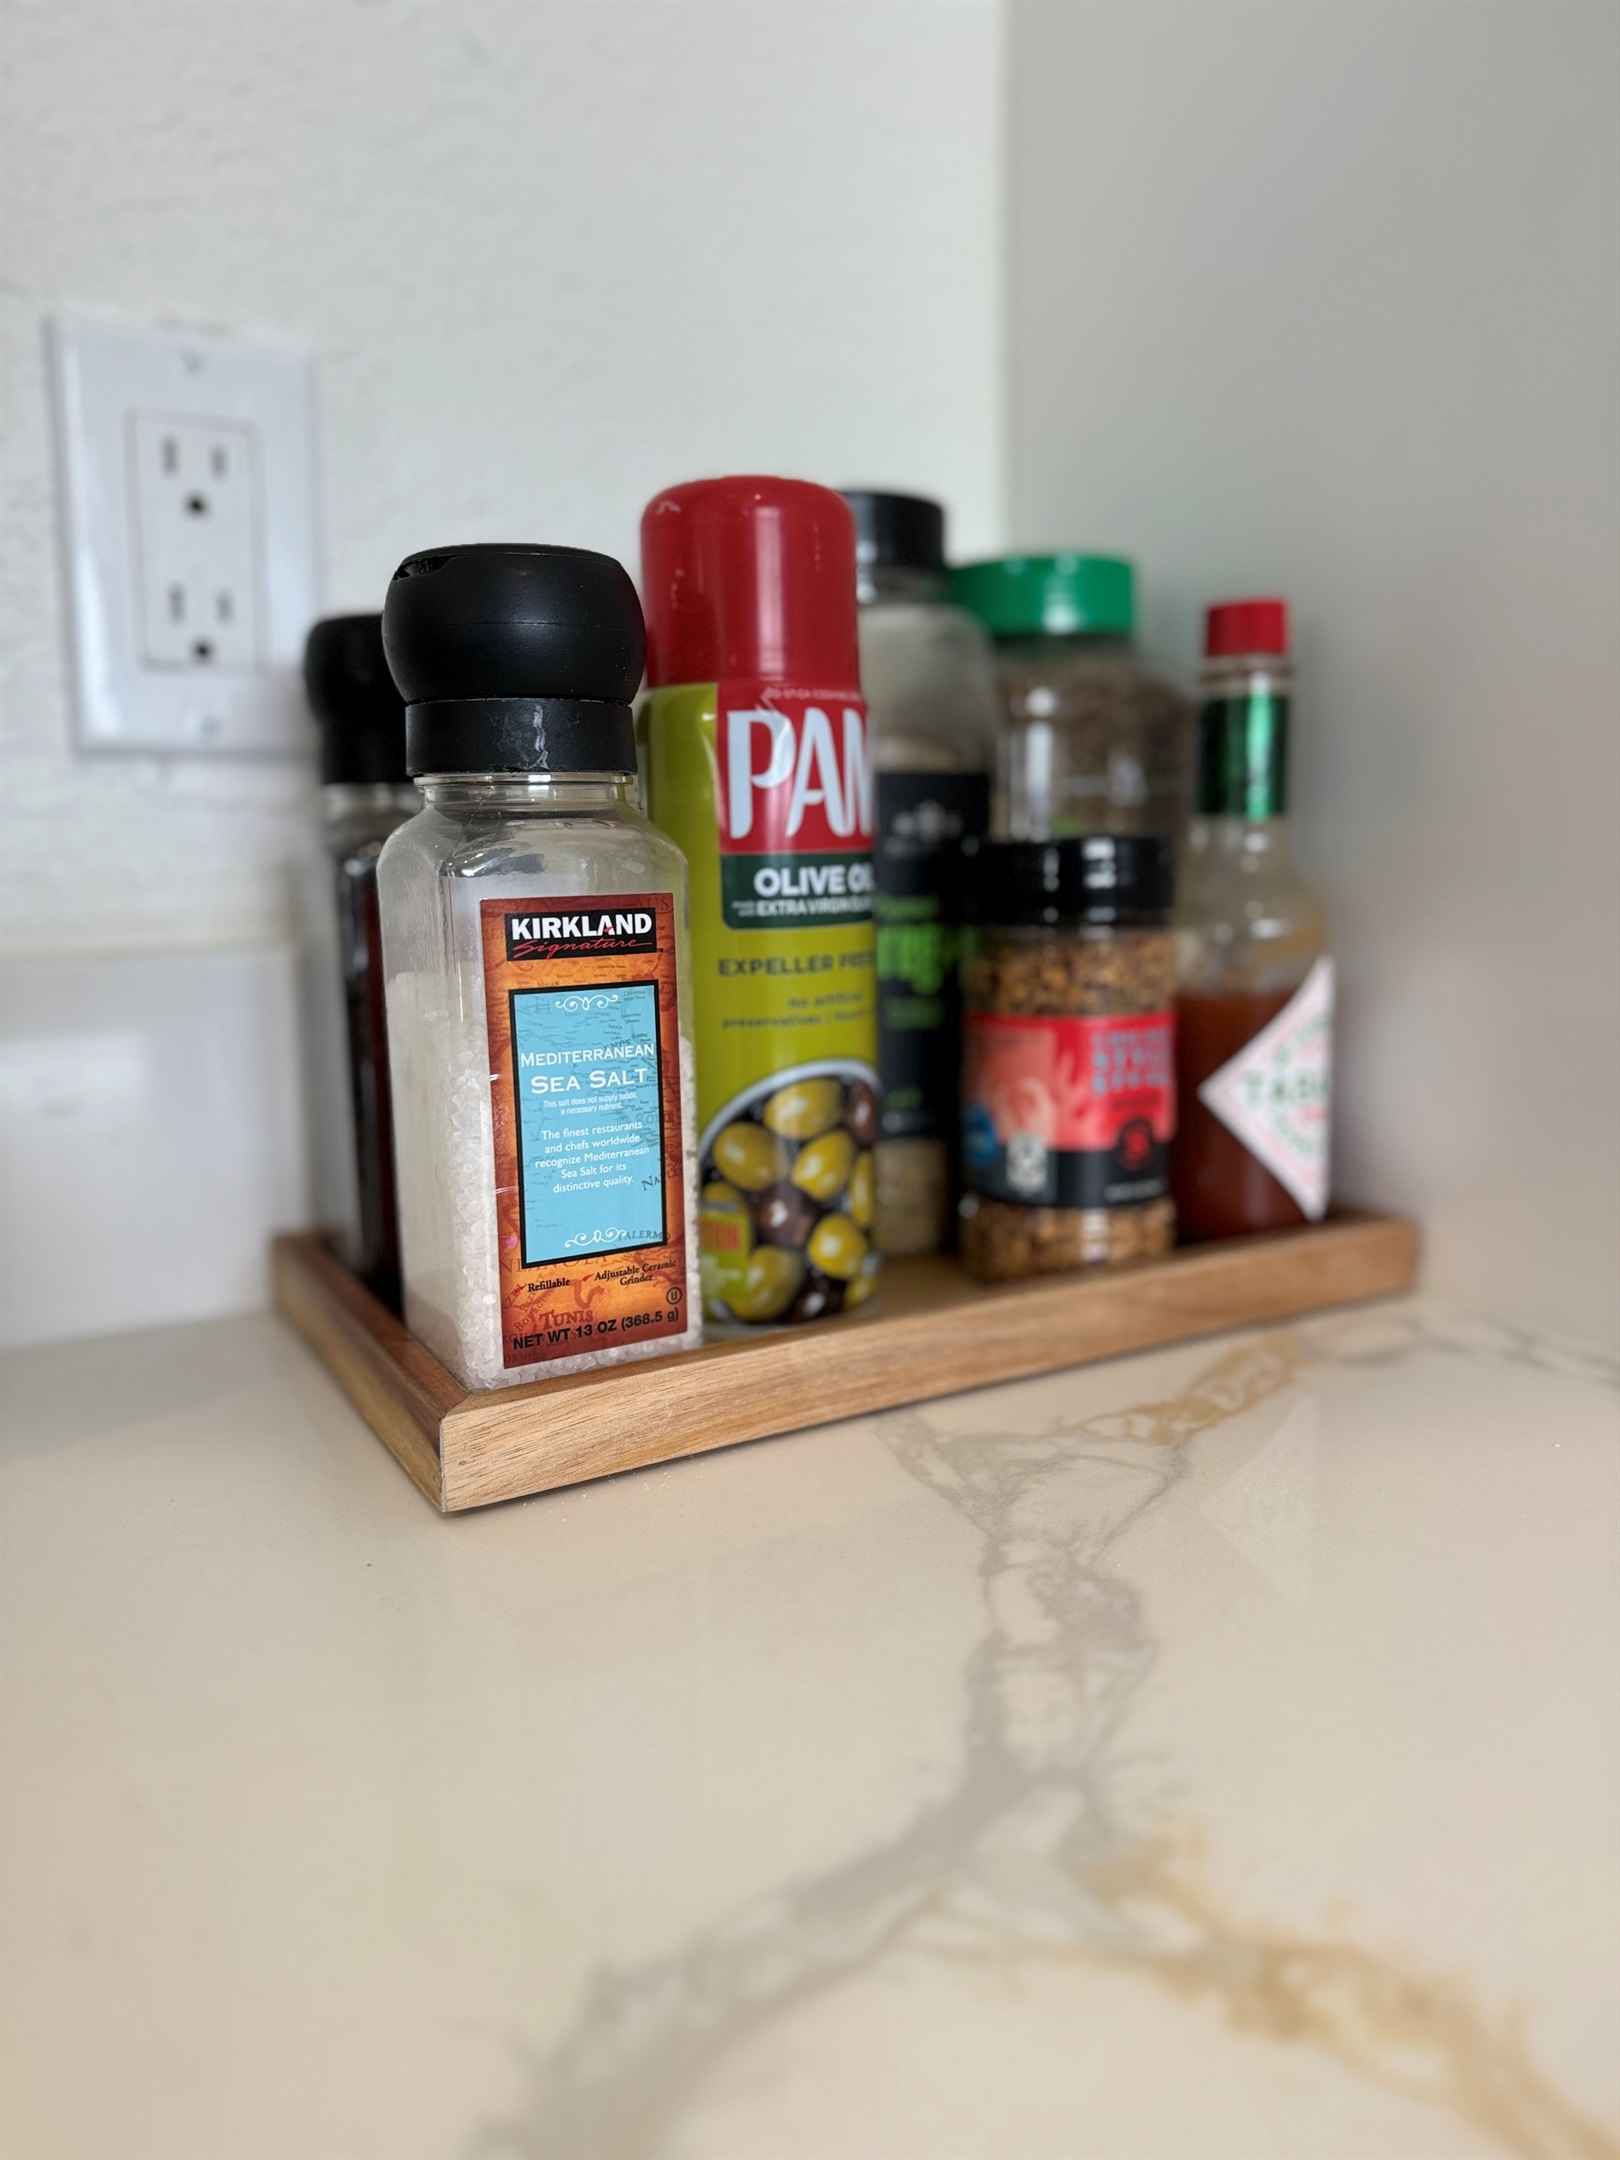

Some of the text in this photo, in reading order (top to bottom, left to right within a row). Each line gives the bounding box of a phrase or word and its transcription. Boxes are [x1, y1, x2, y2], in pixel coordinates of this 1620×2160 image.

[754, 865, 846, 898] OLIVE
[757, 899, 807, 917] EXTRA
[512, 913, 652, 940] KIRKLAND
[513, 938, 653, 959] Signature
[718, 955, 833, 977] EXPELLER
[521, 1044, 654, 1067] MEDITERRANEAN
[531, 1068, 647, 1094] SEA SALT
[543, 1100, 558, 1108] This
[558, 1099, 571, 1107] salt
[571, 1097, 586, 1106] does
[587, 1096, 598, 1104] not
[598, 1092, 619, 1104] supply
[566, 1105, 597, 1115] necessary
[541, 1121, 643, 1141] The finest restaurants
[545, 1134, 641, 1154] and chefs worldwide
[535, 1146, 650, 1169] recognize Mediterranean
[561, 1162, 627, 1179] Sea Salt for its
[553, 1174, 635, 1193] distinctive quality.
[594, 1265, 640, 1282] Adjustable
[642, 1259, 677, 1273] Ceramic
[620, 1273, 653, 1287] Grinder
[528, 1278, 570, 1293] Refillable
[513, 1307, 679, 1350] NET WT 13 OZ (368.5 g)
[539, 1309, 593, 1331] TUNIS
